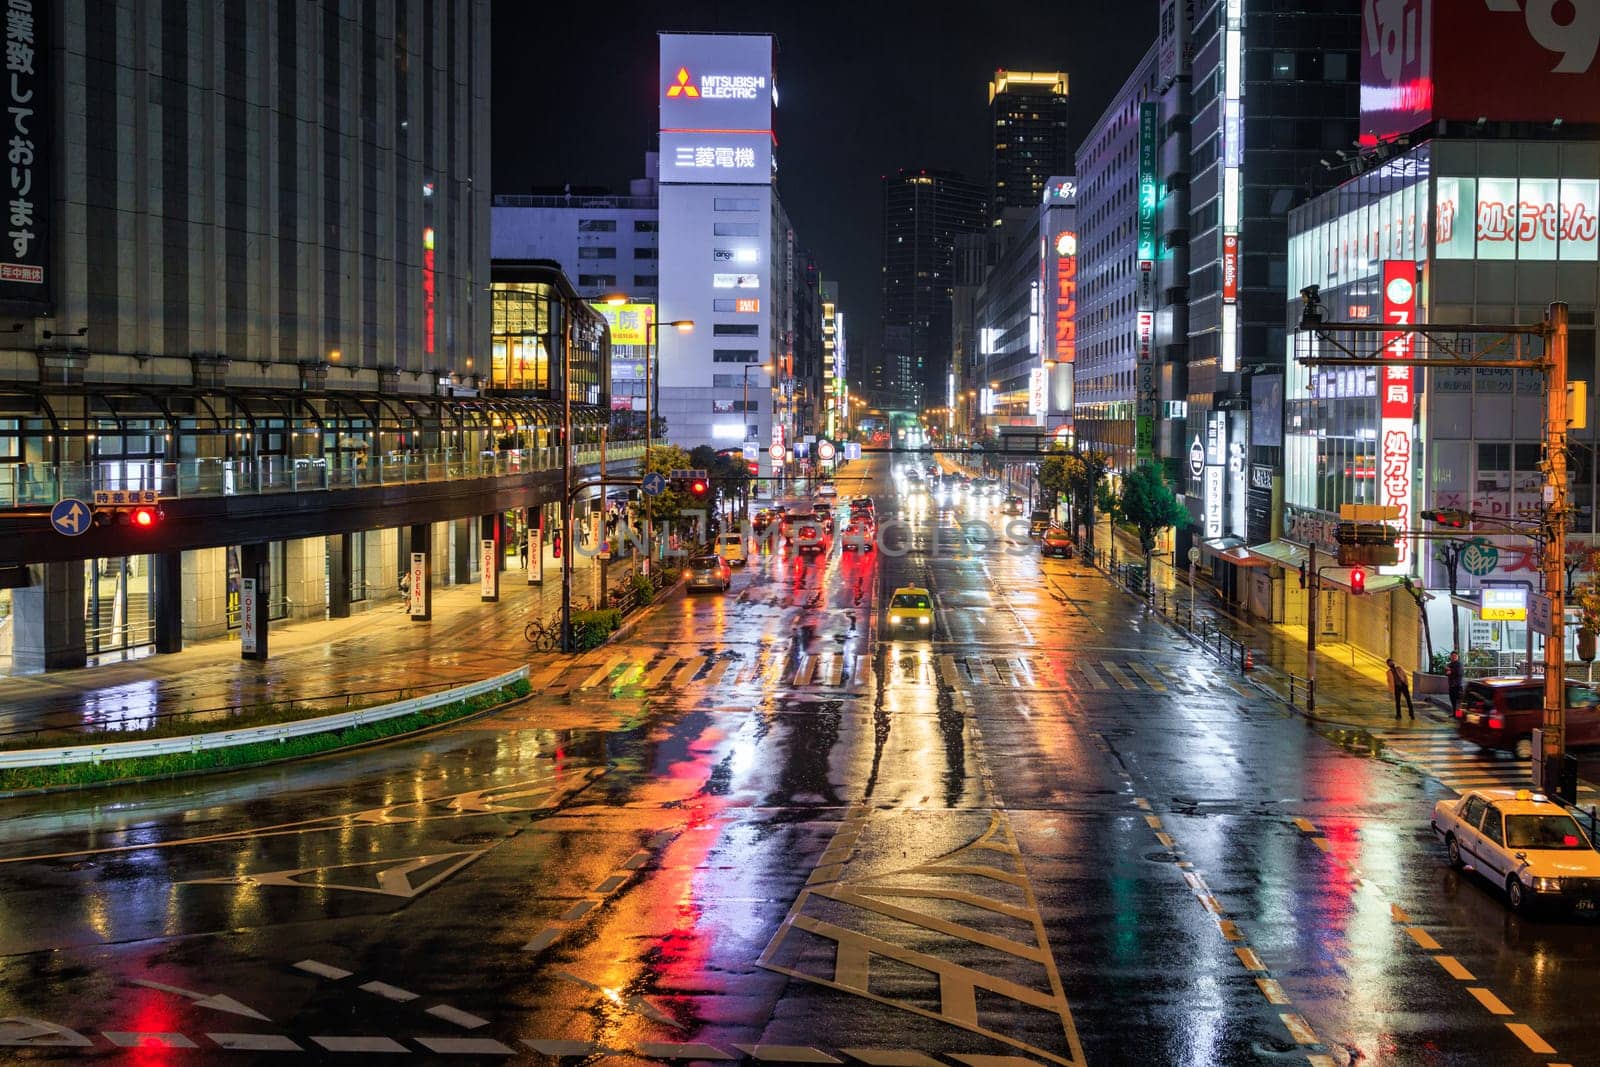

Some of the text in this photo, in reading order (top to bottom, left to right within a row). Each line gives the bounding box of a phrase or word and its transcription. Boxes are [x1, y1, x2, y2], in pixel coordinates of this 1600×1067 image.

[701, 75, 765, 88] MITSUBISHI
[701, 86, 757, 98] ELECTRIC
[675, 147, 755, 168] 三菱電機
[1478, 201, 1597, 242] 処方せん
[1056, 256, 1077, 362] ジャンカラ
